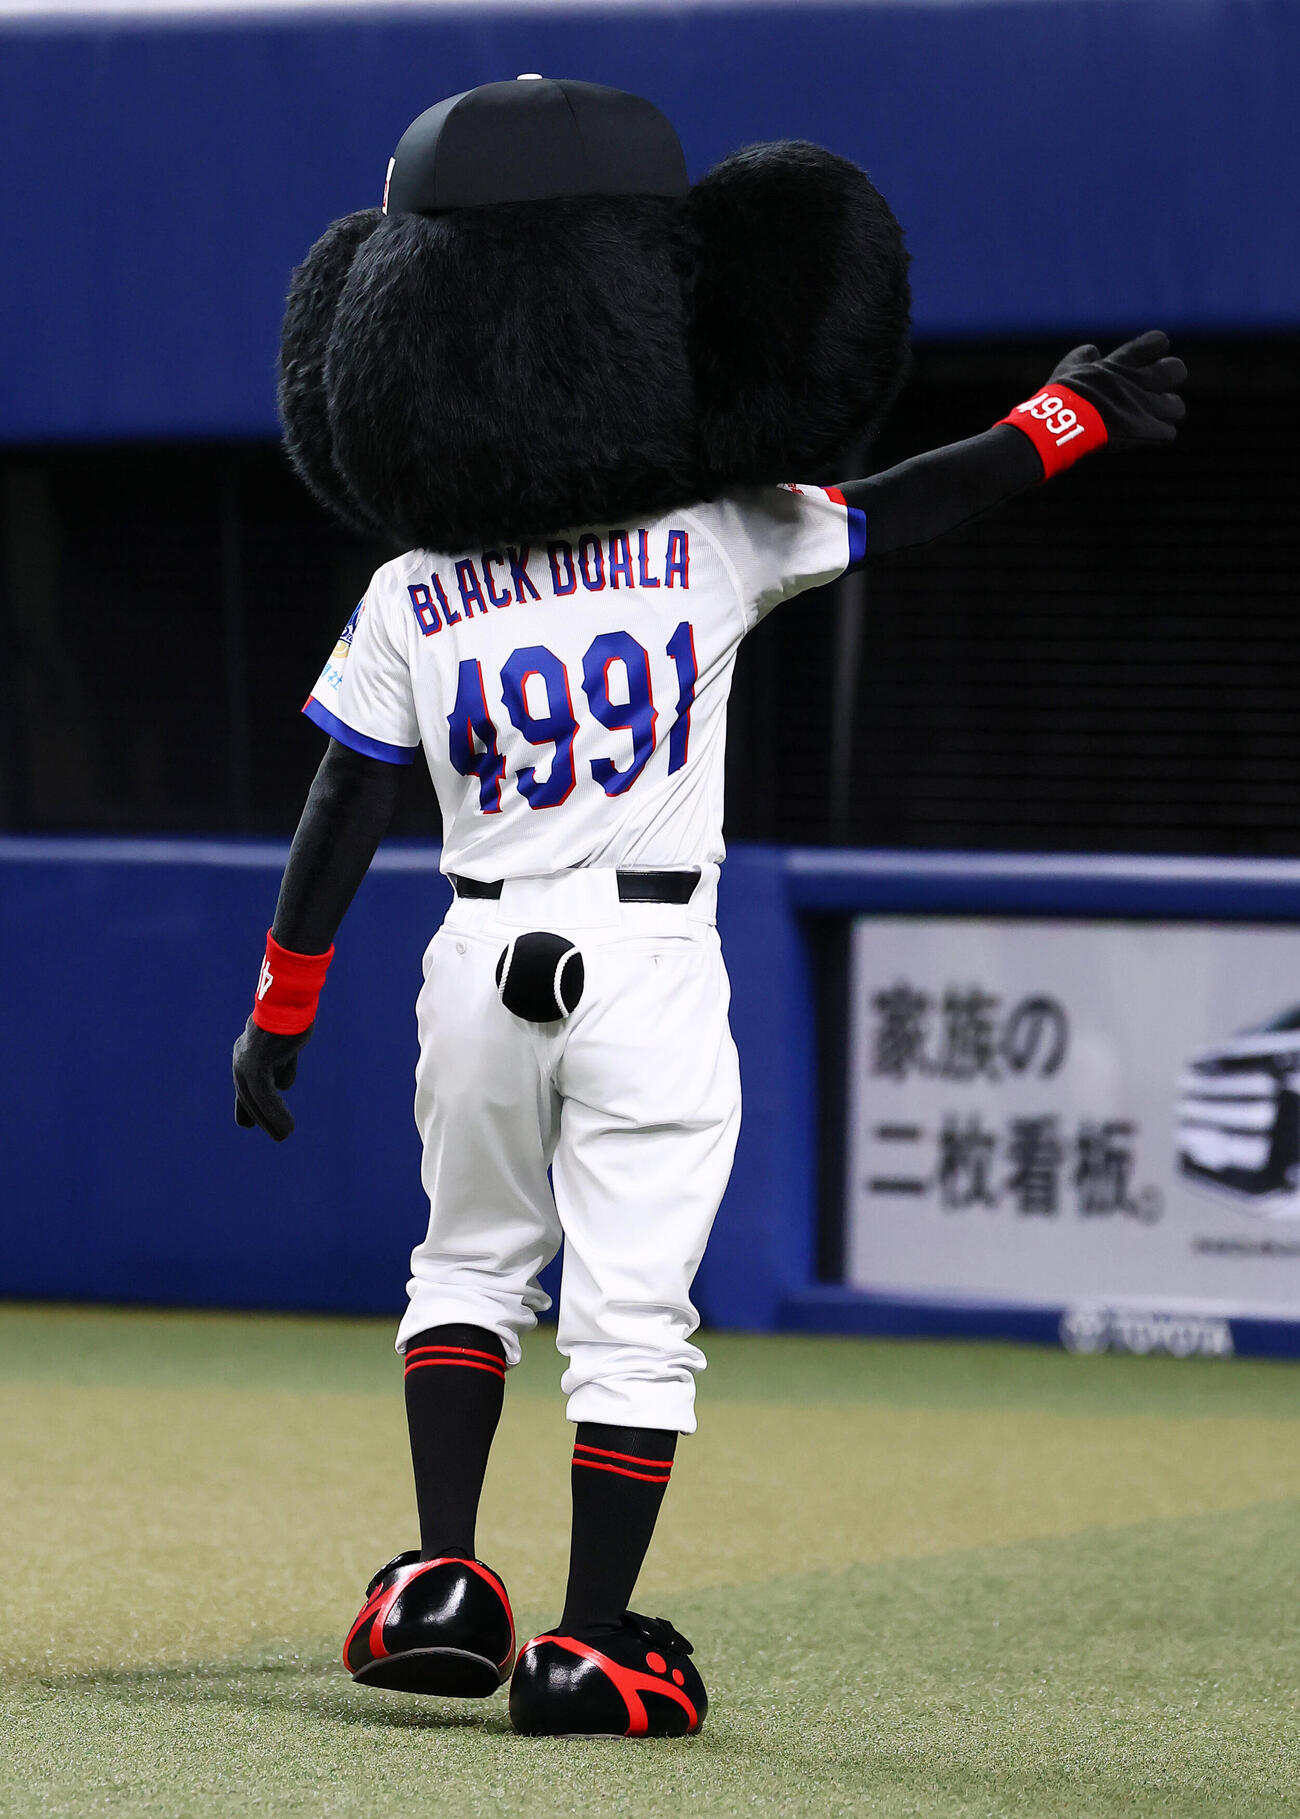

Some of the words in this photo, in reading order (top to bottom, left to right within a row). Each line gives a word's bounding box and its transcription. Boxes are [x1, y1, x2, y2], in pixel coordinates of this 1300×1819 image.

[407, 544, 542, 637] BLACK
[547, 528, 690, 597] DOALA
[447, 621, 699, 814] 4991
